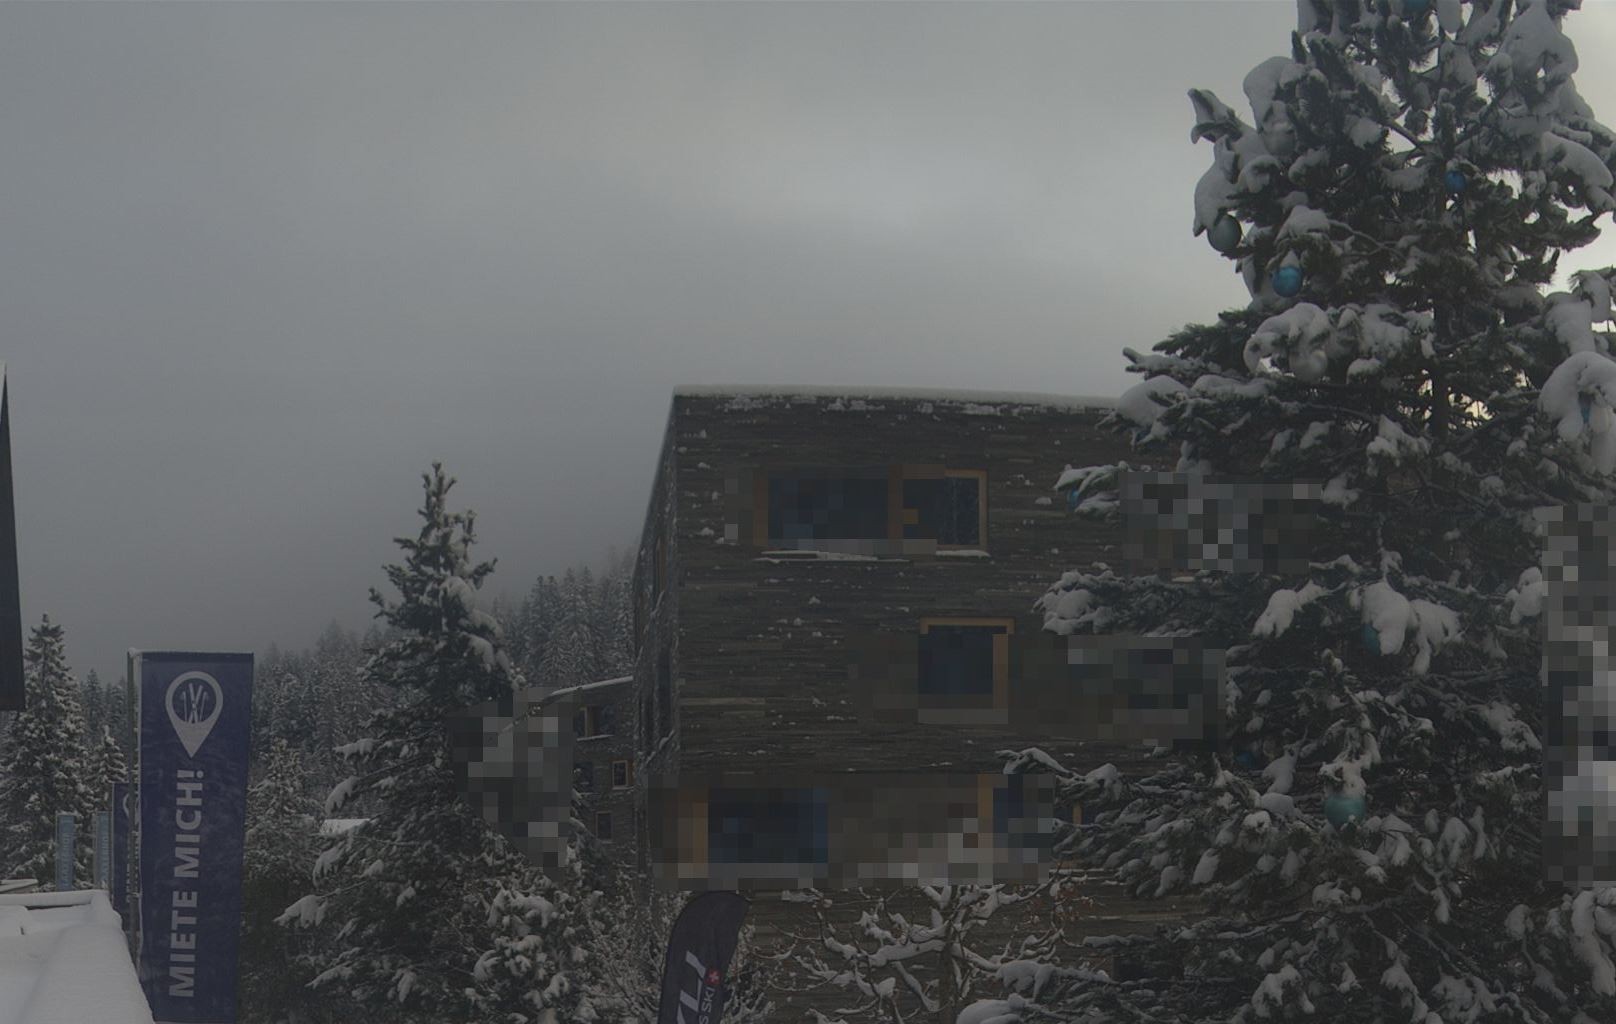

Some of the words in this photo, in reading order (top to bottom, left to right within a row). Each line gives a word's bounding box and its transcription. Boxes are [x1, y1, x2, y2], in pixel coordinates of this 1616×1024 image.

[174, 769, 205, 879] MICH!
[168, 890, 198, 998] MIETE
[701, 986, 716, 1014] SKI
